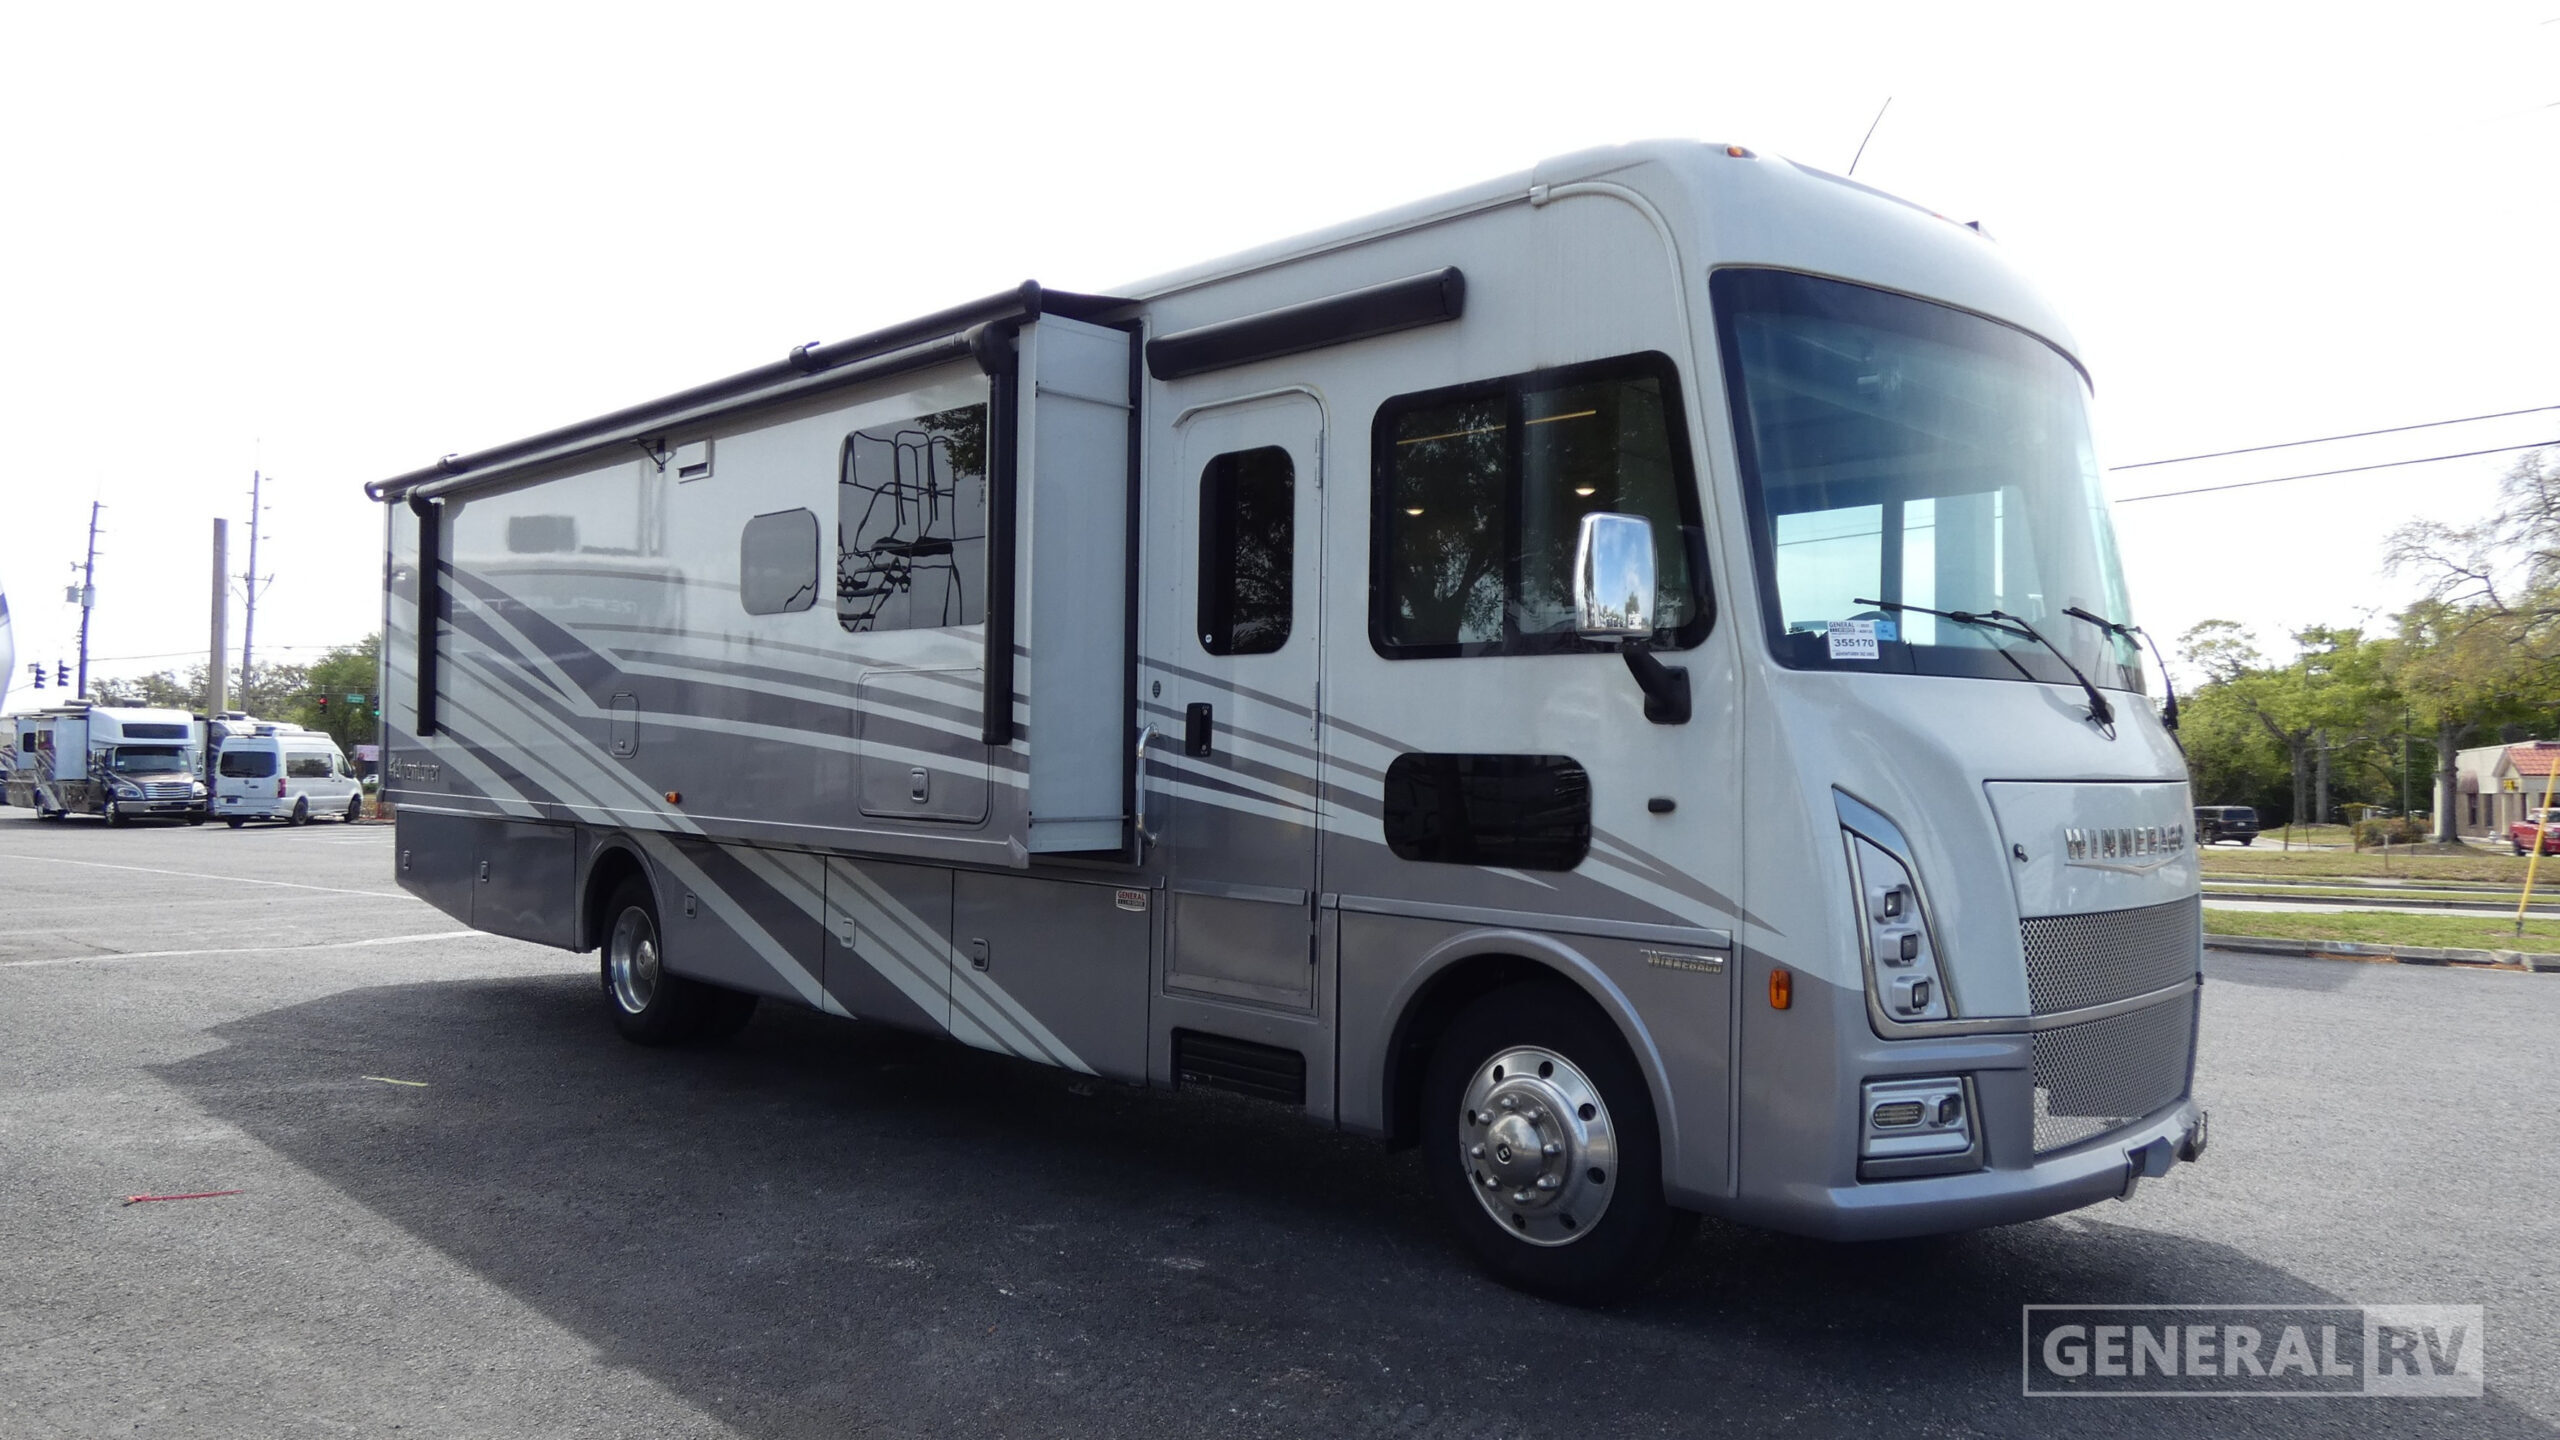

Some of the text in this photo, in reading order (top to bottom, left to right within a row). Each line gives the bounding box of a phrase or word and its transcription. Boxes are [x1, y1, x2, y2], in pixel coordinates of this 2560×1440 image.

[1834, 638, 1874, 648] 355170
[2064, 823, 2184, 860] WINNEBAGO
[1118, 890, 1145, 901] GENERAL
